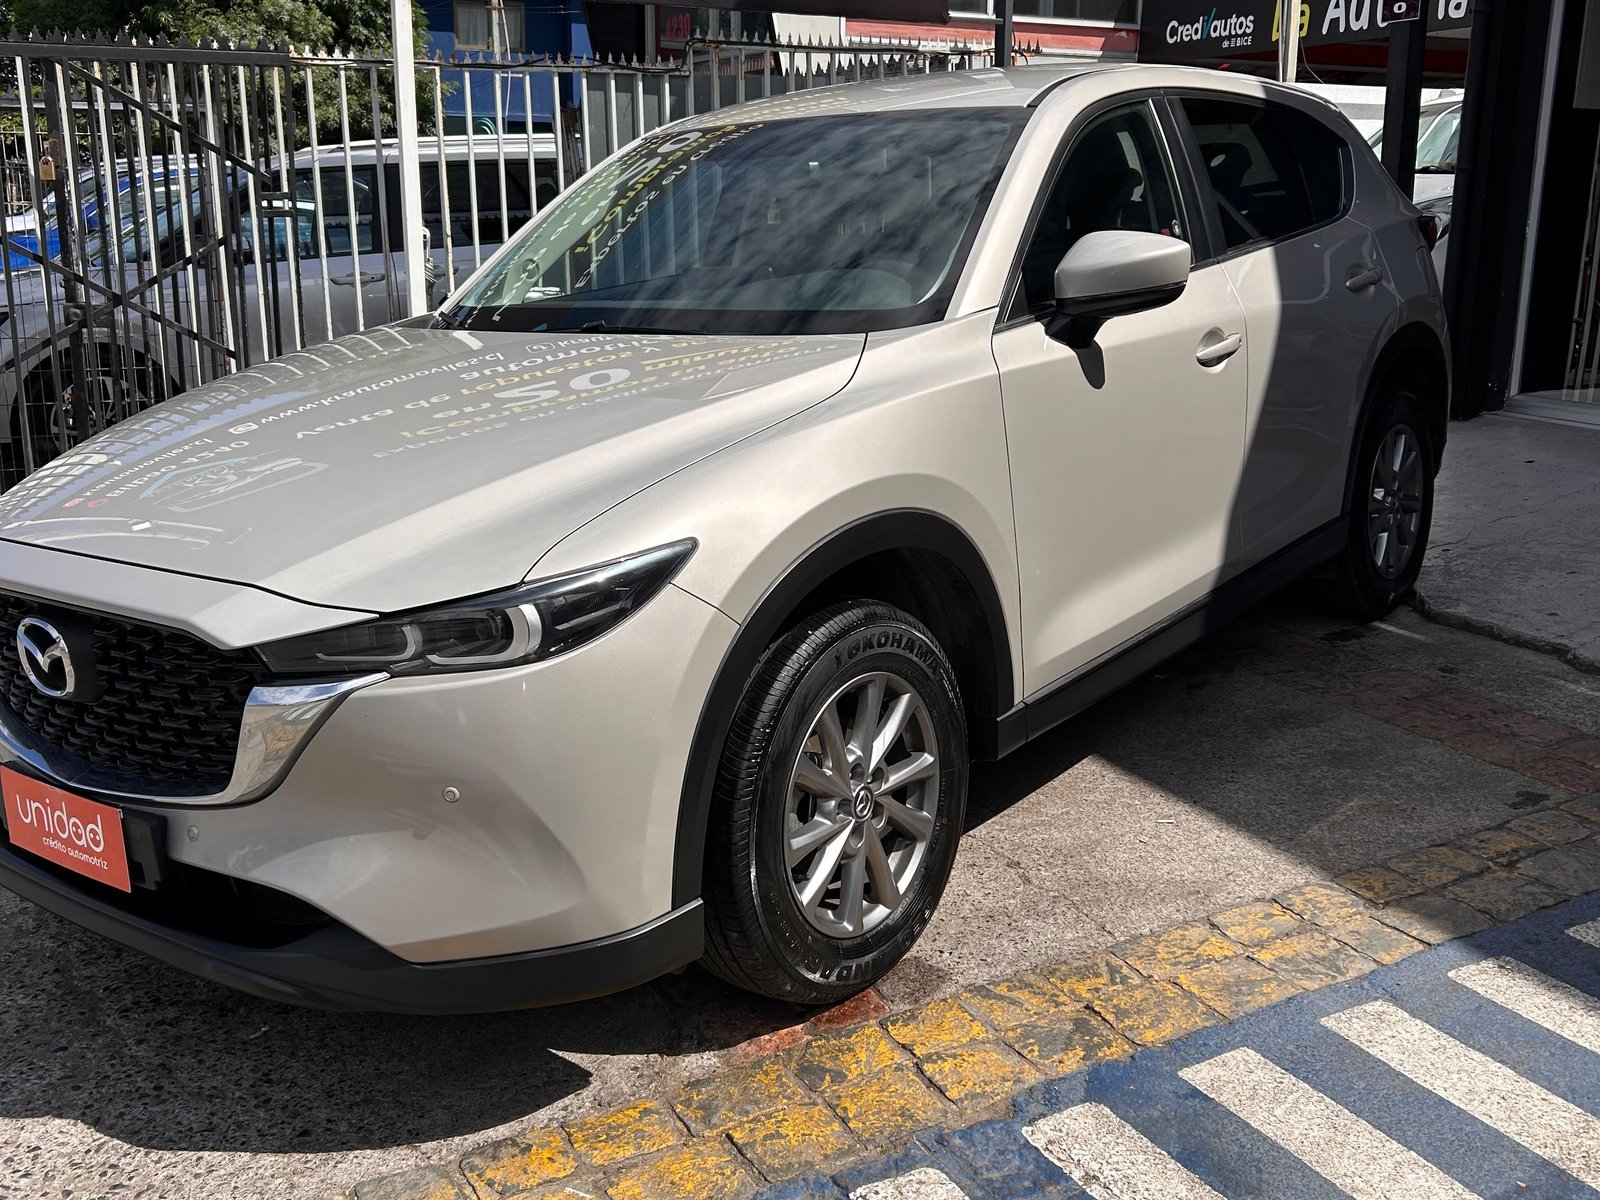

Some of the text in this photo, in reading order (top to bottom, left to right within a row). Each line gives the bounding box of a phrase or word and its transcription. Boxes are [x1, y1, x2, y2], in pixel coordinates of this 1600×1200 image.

[832, 630, 940, 676] YOKOHAMA
[16, 794, 105, 852] unidad
[42, 836, 109, 870] crédito automotriz
